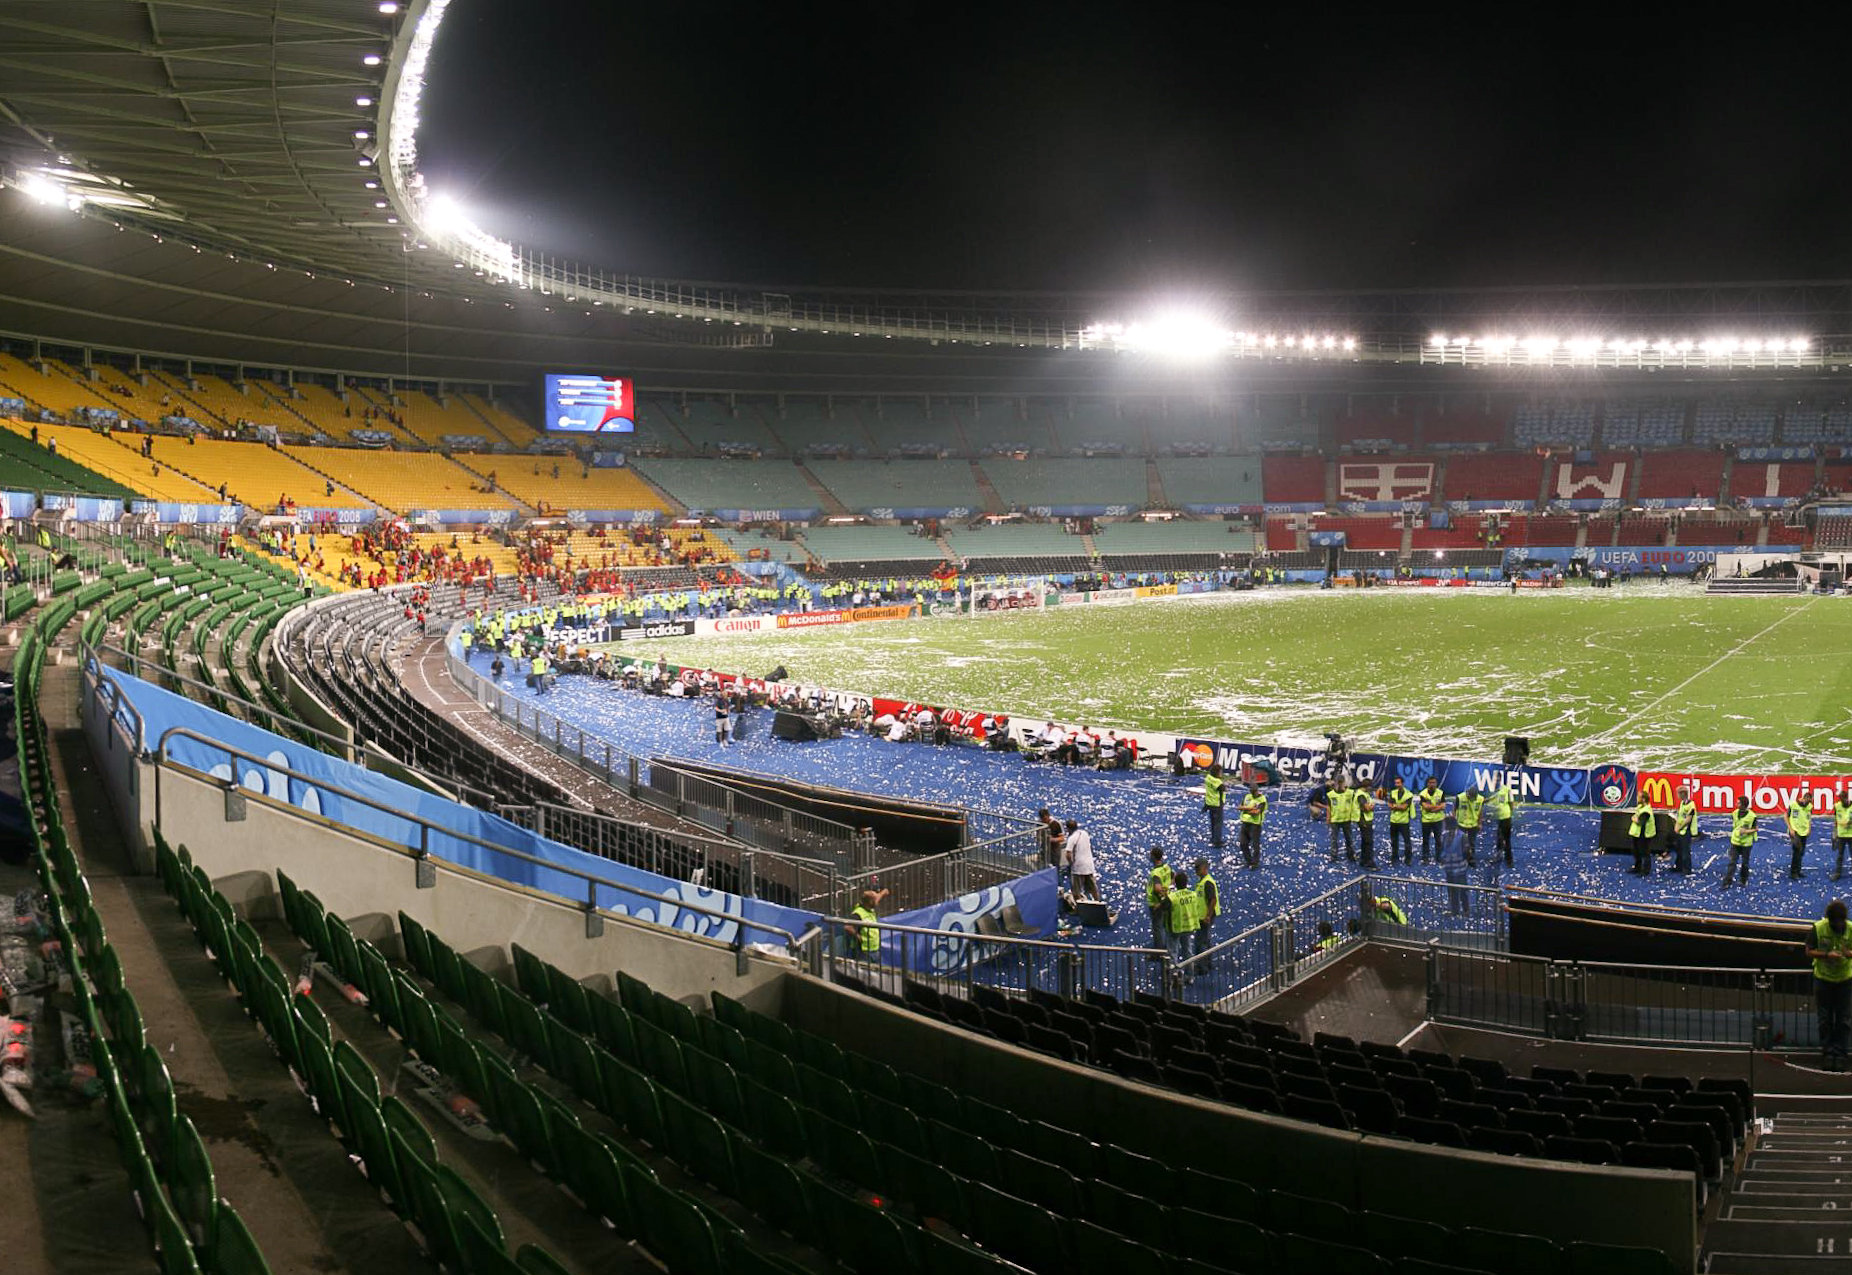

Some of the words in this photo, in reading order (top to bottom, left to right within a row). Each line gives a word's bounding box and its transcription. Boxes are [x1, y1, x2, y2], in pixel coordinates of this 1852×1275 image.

[339, 510, 361, 523] 2008
[752, 510, 780, 521] WIEN
[1602, 551, 1639, 564] UEFA
[1641, 551, 1685, 564] EURO
[1687, 551, 1722, 563] 200
[788, 612, 842, 626] McDonald's
[853, 607, 899, 622] Continental
[646, 623, 685, 638] adidas
[714, 620, 760, 632] Canon
[1218, 747, 1376, 785] MterCad
[1474, 768, 1541, 797] WIEN
